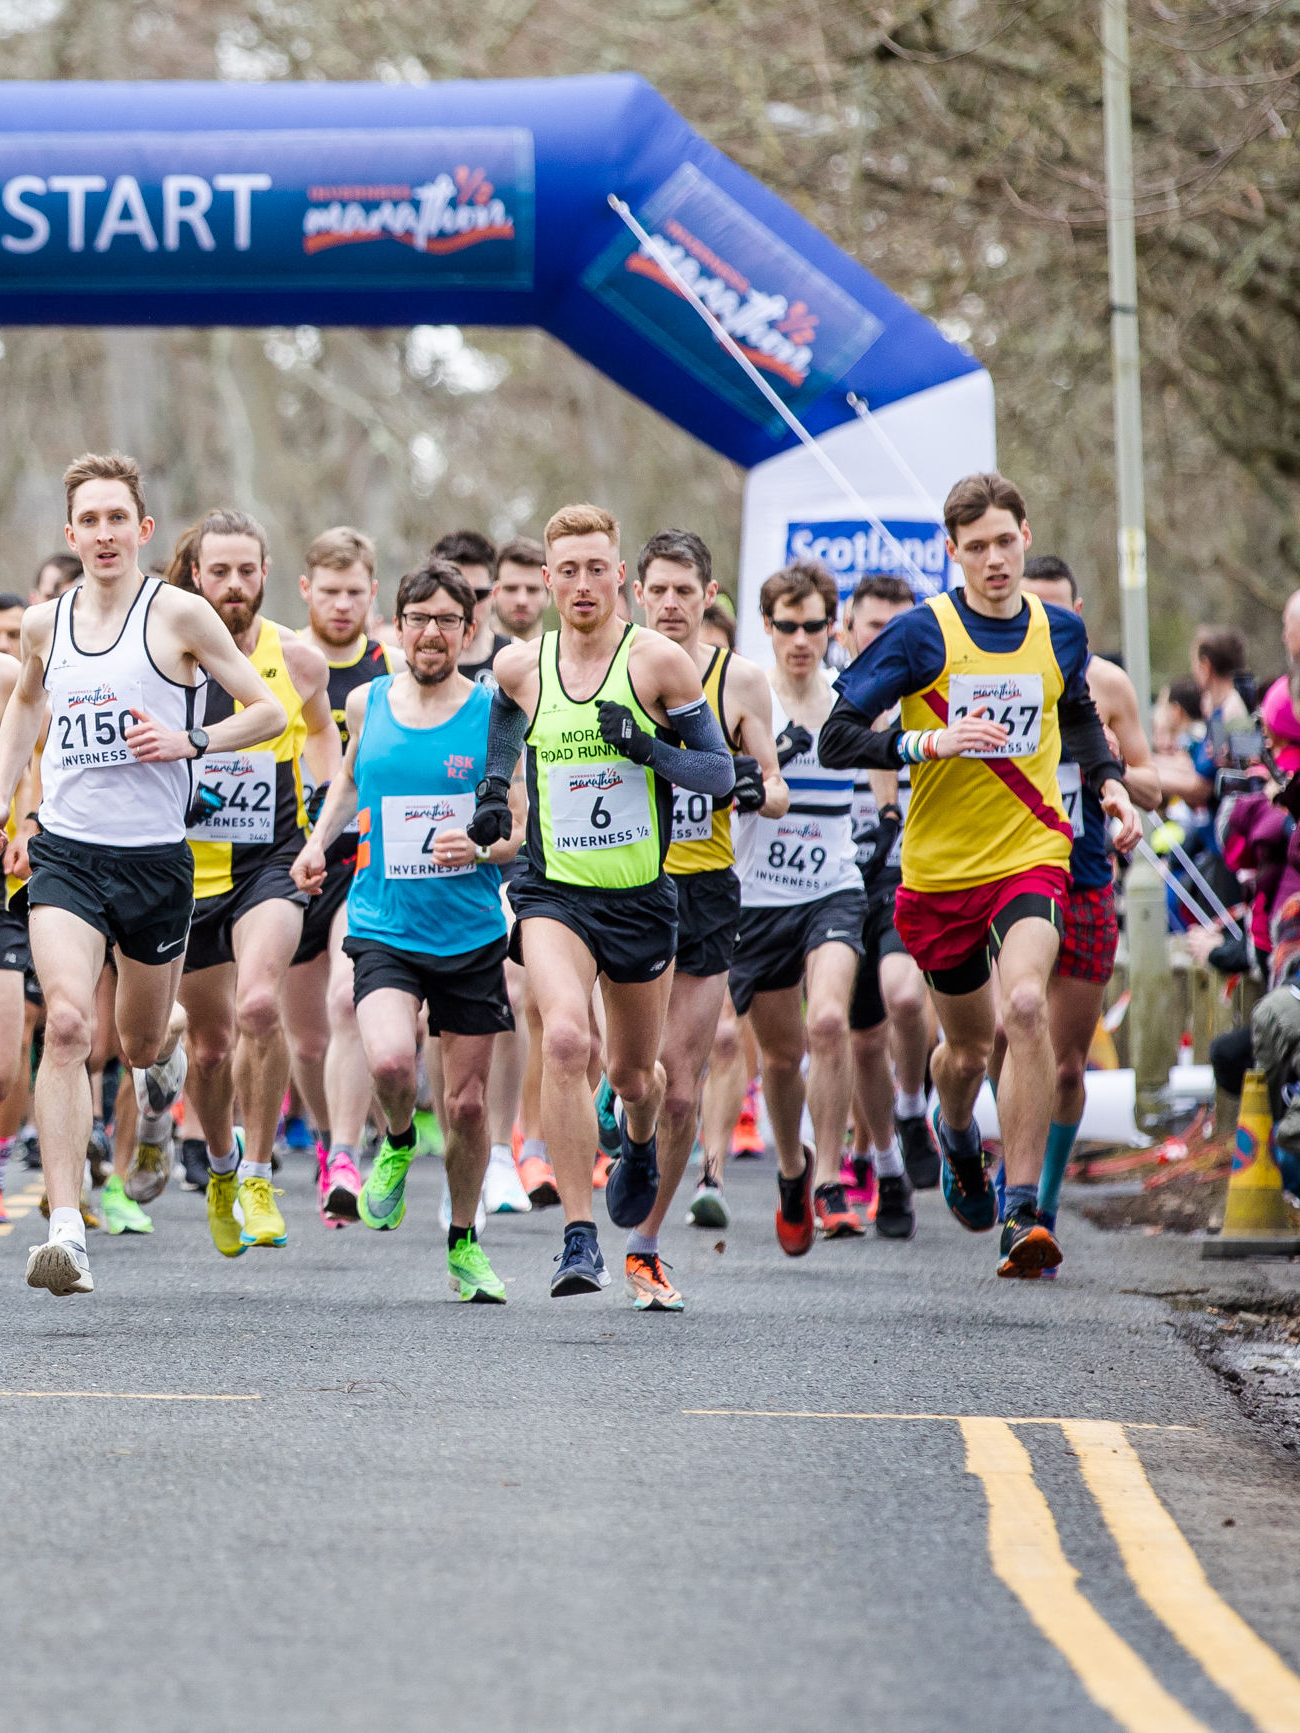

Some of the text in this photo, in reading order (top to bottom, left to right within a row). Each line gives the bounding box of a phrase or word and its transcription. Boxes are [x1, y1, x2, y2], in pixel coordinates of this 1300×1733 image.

[0, 173, 272, 254] START
[303, 172, 513, 253] marathon
[790, 529, 946, 571] Scotland
[68, 686, 115, 705] marathon
[973, 682, 1020, 698] marathon
[58, 710, 138, 749] 2150
[562, 730, 603, 744] MORA
[62, 750, 127, 766] INVERNESS
[443, 754, 474, 770] JSK
[541, 744, 618, 763] ROAD RUNN
[570, 771, 622, 789] marathon
[405, 803, 454, 820] marathon
[590, 796, 612, 829] 6
[205, 818, 255, 827] ERNESS
[557, 830, 633, 848] INVERNESS
[768, 842, 826, 876] 849
[756, 870, 820, 889] INVERNESS
